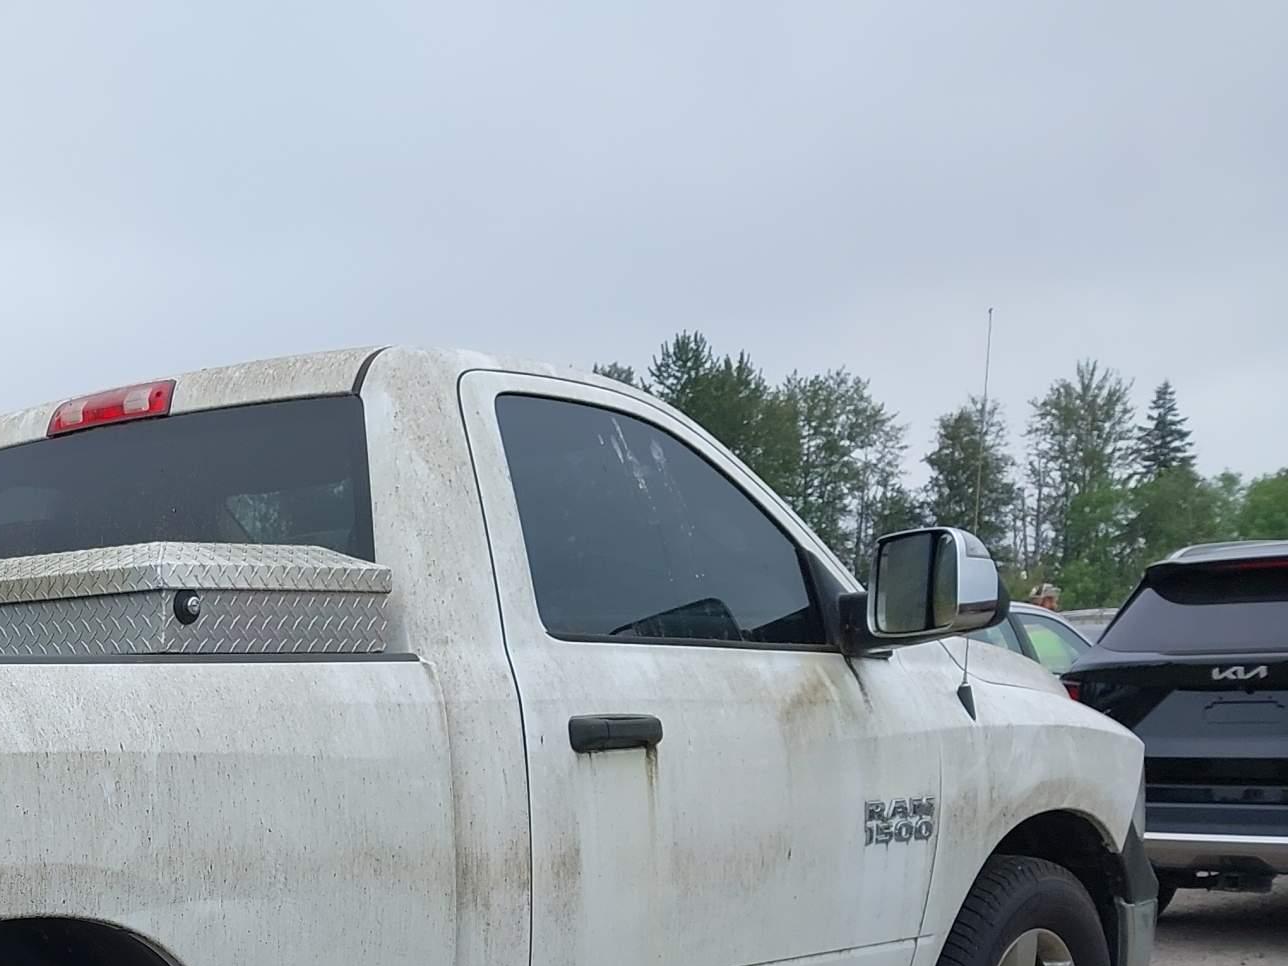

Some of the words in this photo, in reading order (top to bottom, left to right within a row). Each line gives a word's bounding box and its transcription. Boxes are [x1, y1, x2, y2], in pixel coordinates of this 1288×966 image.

[1212, 665, 1268, 680] KIA
[864, 797, 934, 821] RAM
[864, 820, 933, 846] 1500
